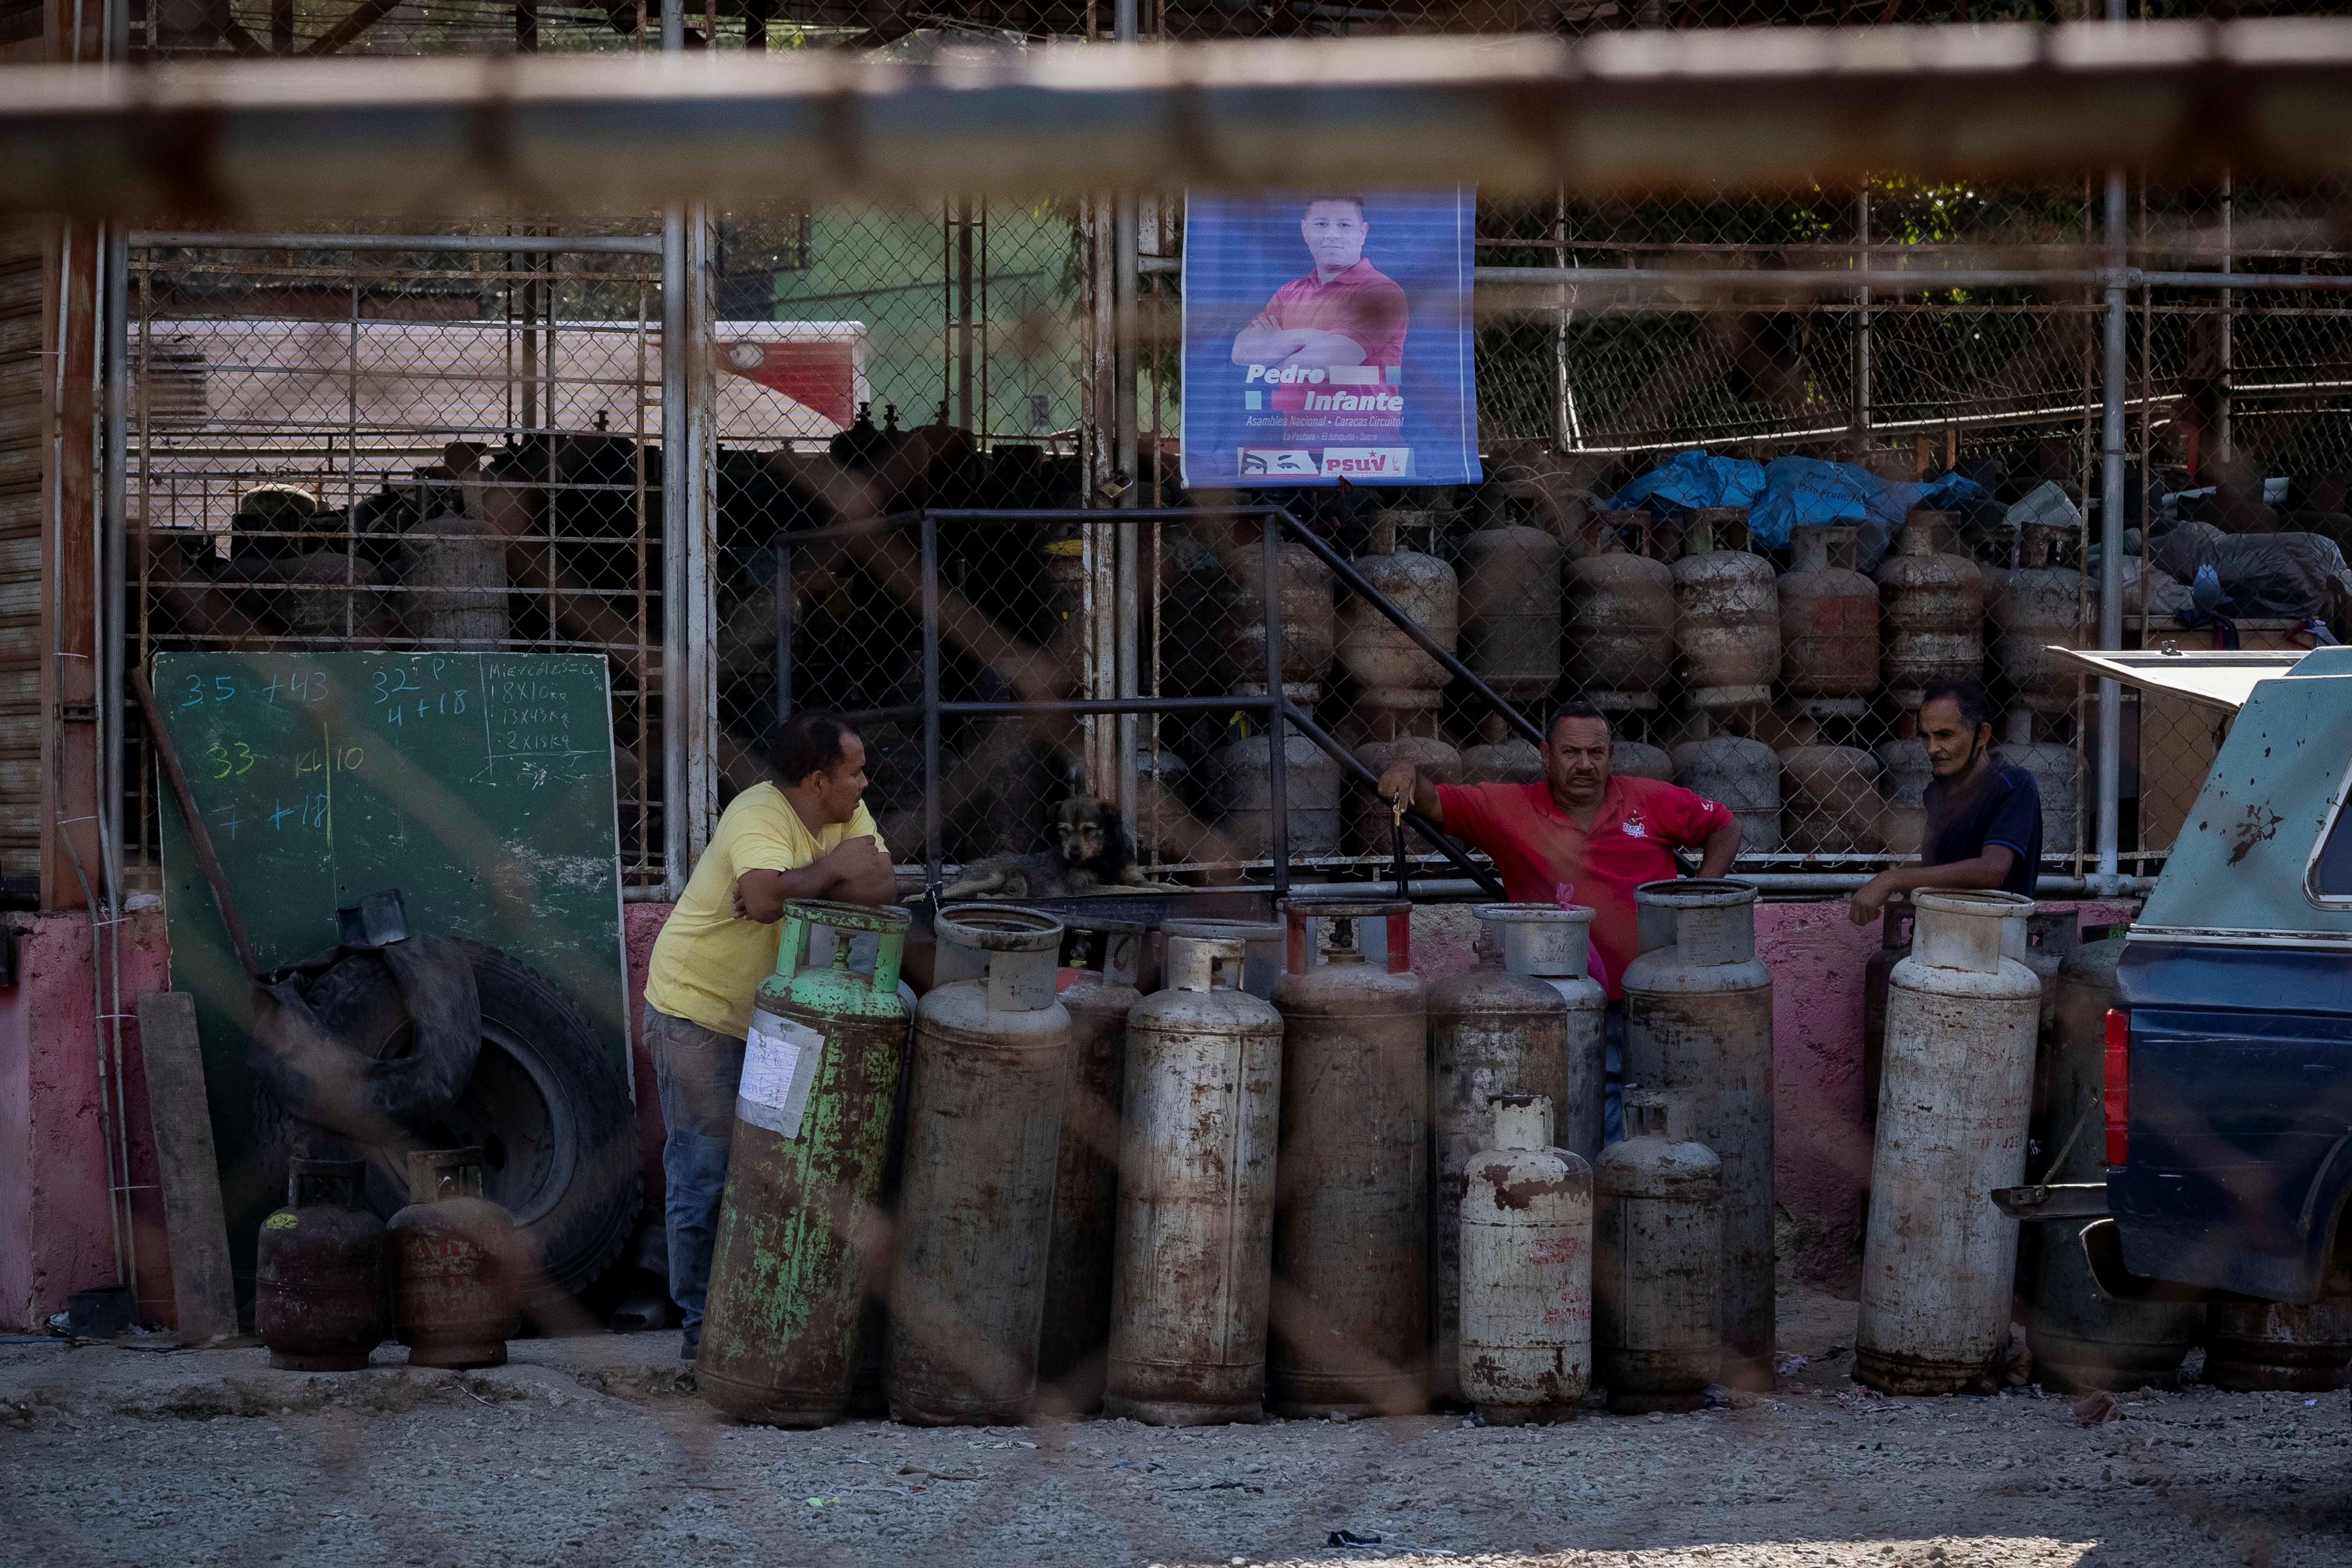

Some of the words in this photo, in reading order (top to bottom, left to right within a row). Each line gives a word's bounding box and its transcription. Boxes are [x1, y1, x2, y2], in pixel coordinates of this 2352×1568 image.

[1245, 364, 1325, 384] Pedro
[1304, 391, 1404, 411] Infante
[1246, 415, 1288, 426] Asamblea
[1289, 415, 1327, 426] Nacional
[1335, 415, 1368, 427] Caracas
[1360, 432, 1378, 441] Sucre
[372, 668, 422, 704] 32
[207, 741, 254, 778] 33
